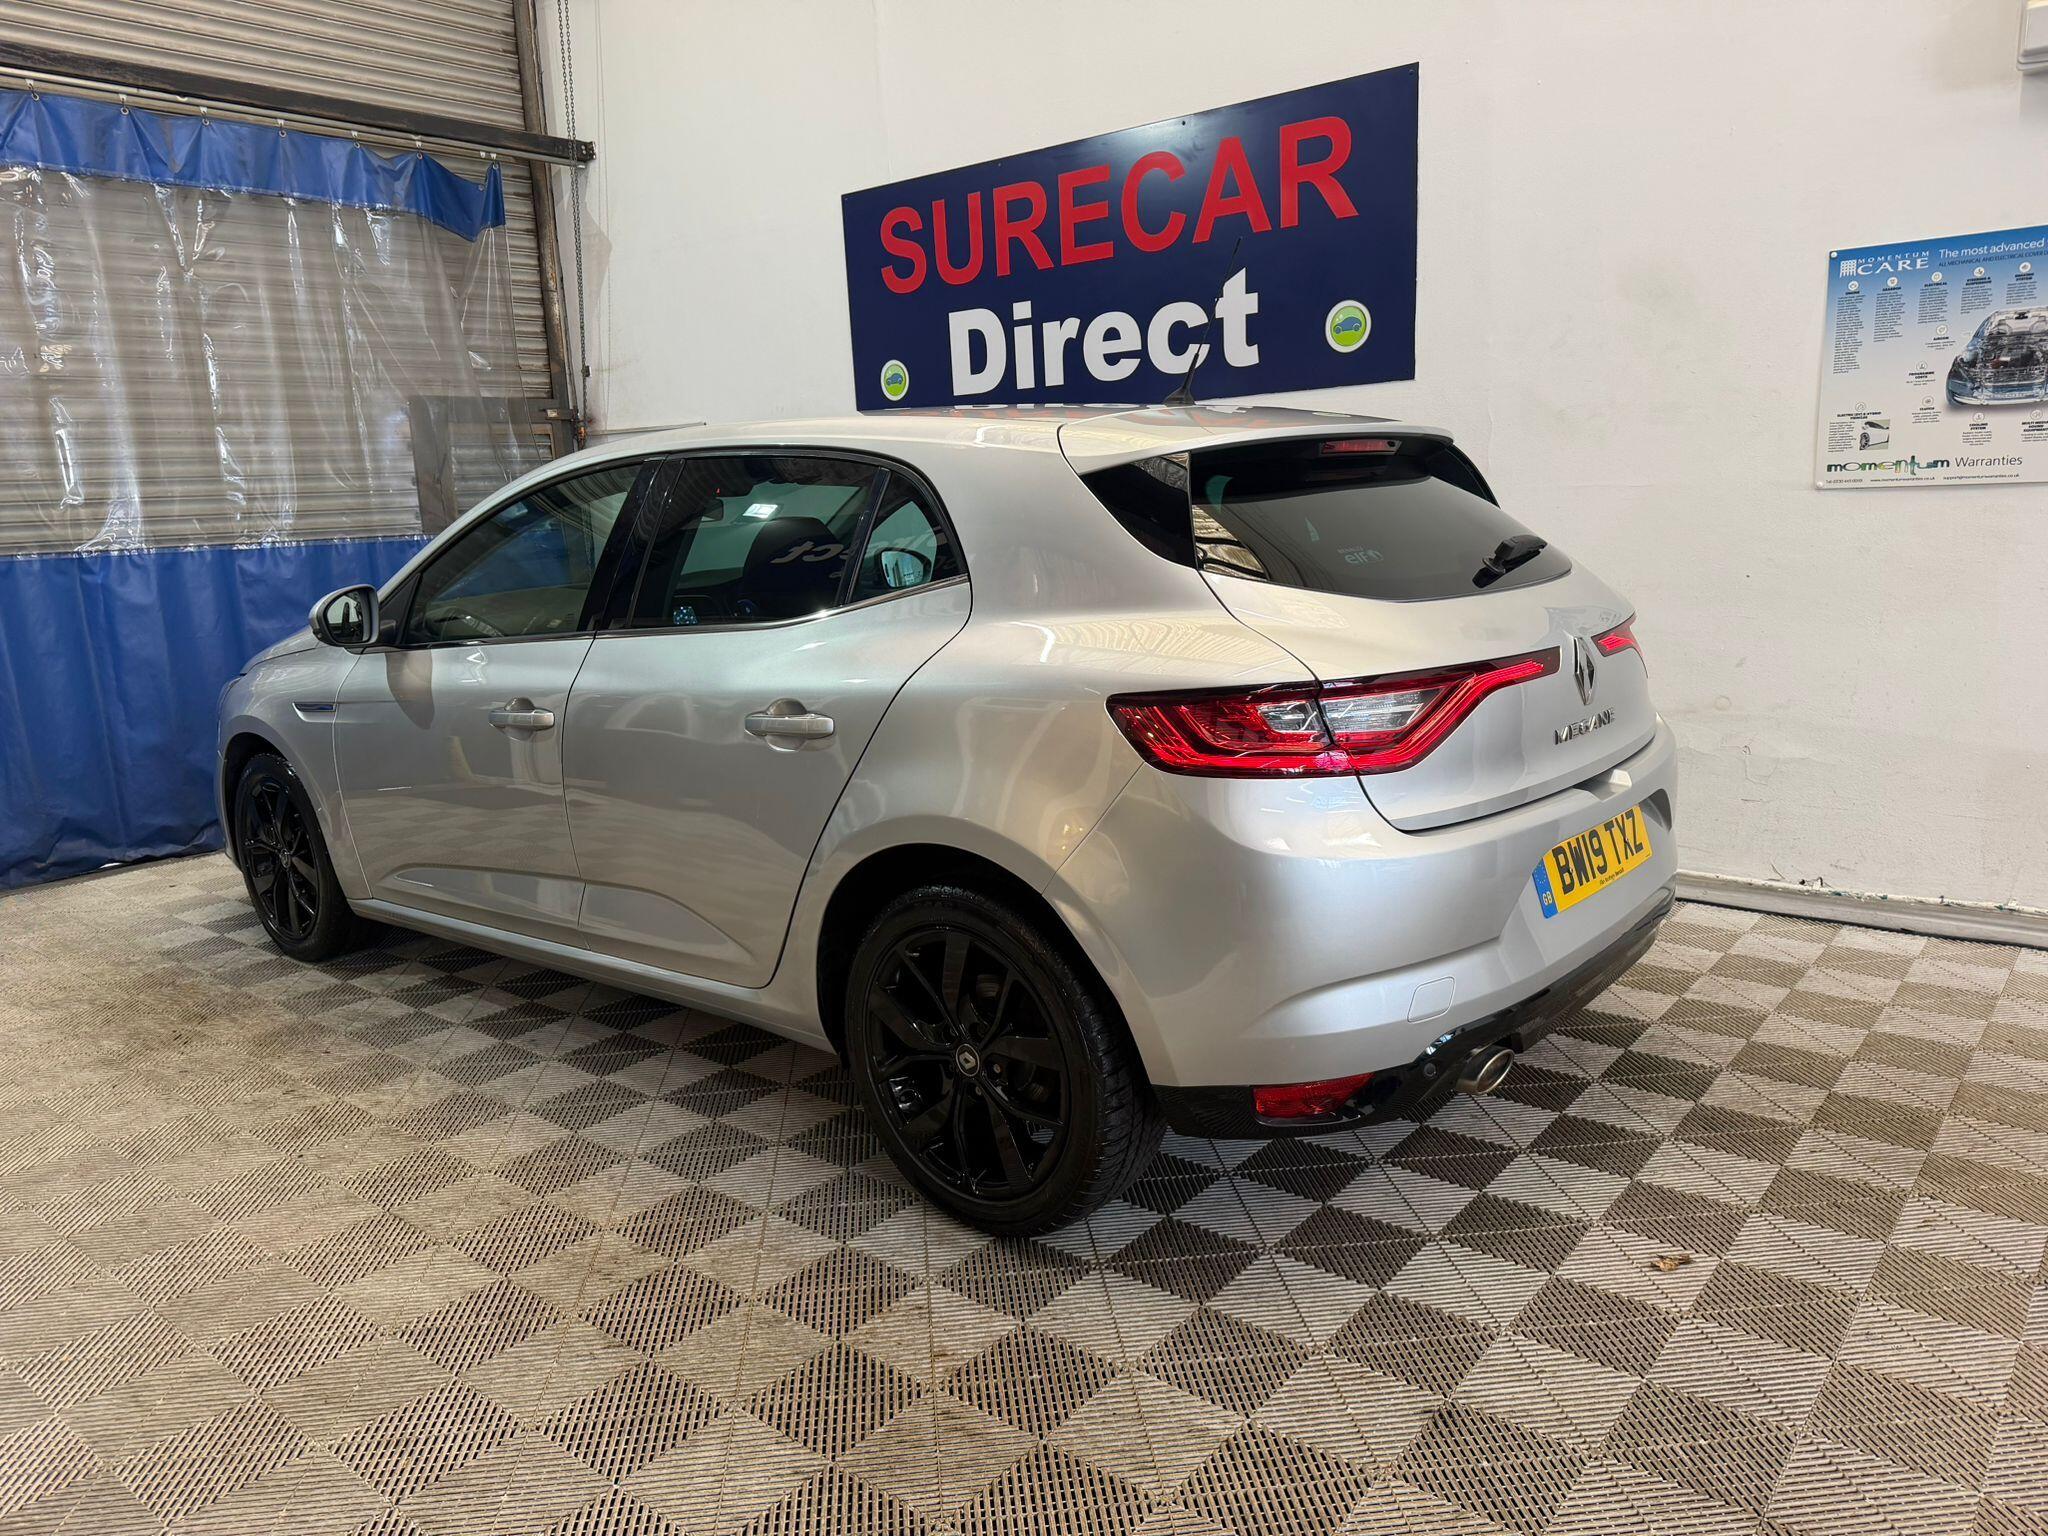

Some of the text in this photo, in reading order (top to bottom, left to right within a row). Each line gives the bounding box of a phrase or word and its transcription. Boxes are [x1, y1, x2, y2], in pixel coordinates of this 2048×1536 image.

[879, 116, 1360, 294] SURECAR
[1858, 251, 1930, 264] MOMENTUM
[1939, 238, 2045, 258] The most advanced
[1857, 258, 1929, 275] CARE
[948, 267, 1260, 396] Direct
[1827, 454, 2023, 475] momentum Warranties
[1554, 707, 1616, 745] MEGANE
[1552, 808, 1644, 895] BW19 TXZ
[1542, 891, 1553, 906] GB
